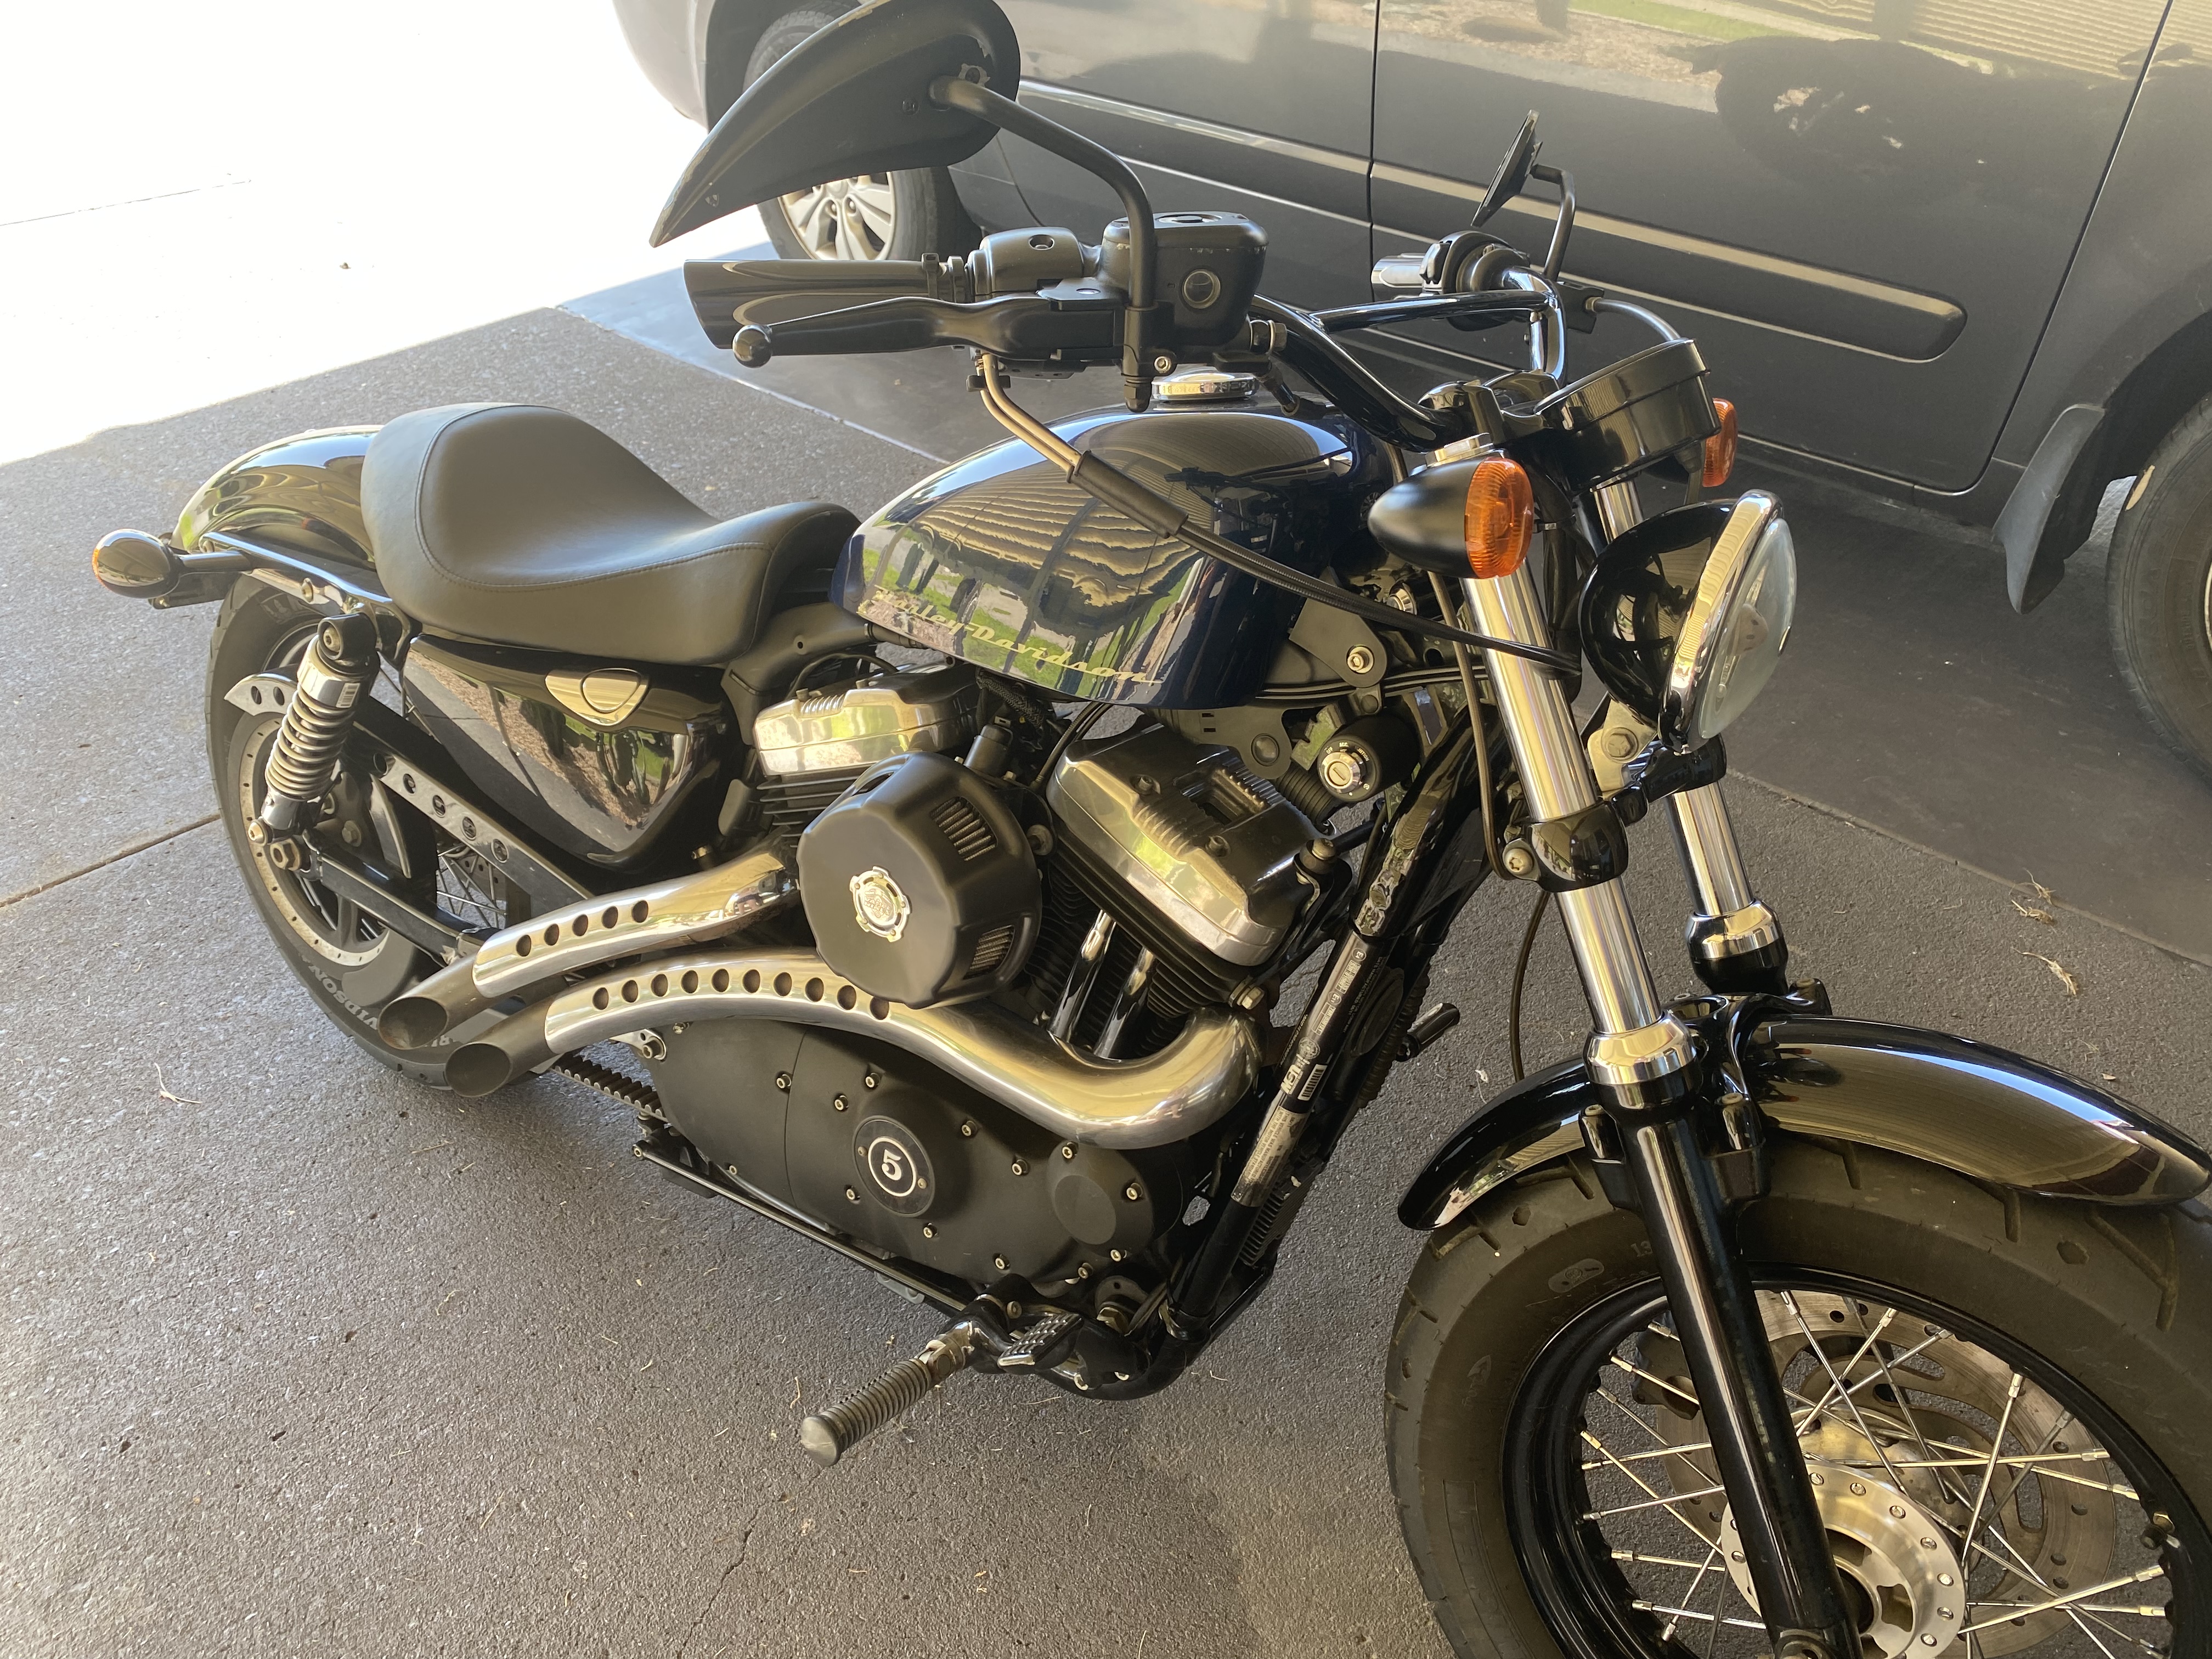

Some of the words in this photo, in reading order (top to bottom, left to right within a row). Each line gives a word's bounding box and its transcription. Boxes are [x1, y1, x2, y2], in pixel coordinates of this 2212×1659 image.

[856, 585, 1163, 686] Harley-Davidson
[1280, 1064, 1301, 1094] USW
[881, 1149, 902, 1181] 5
